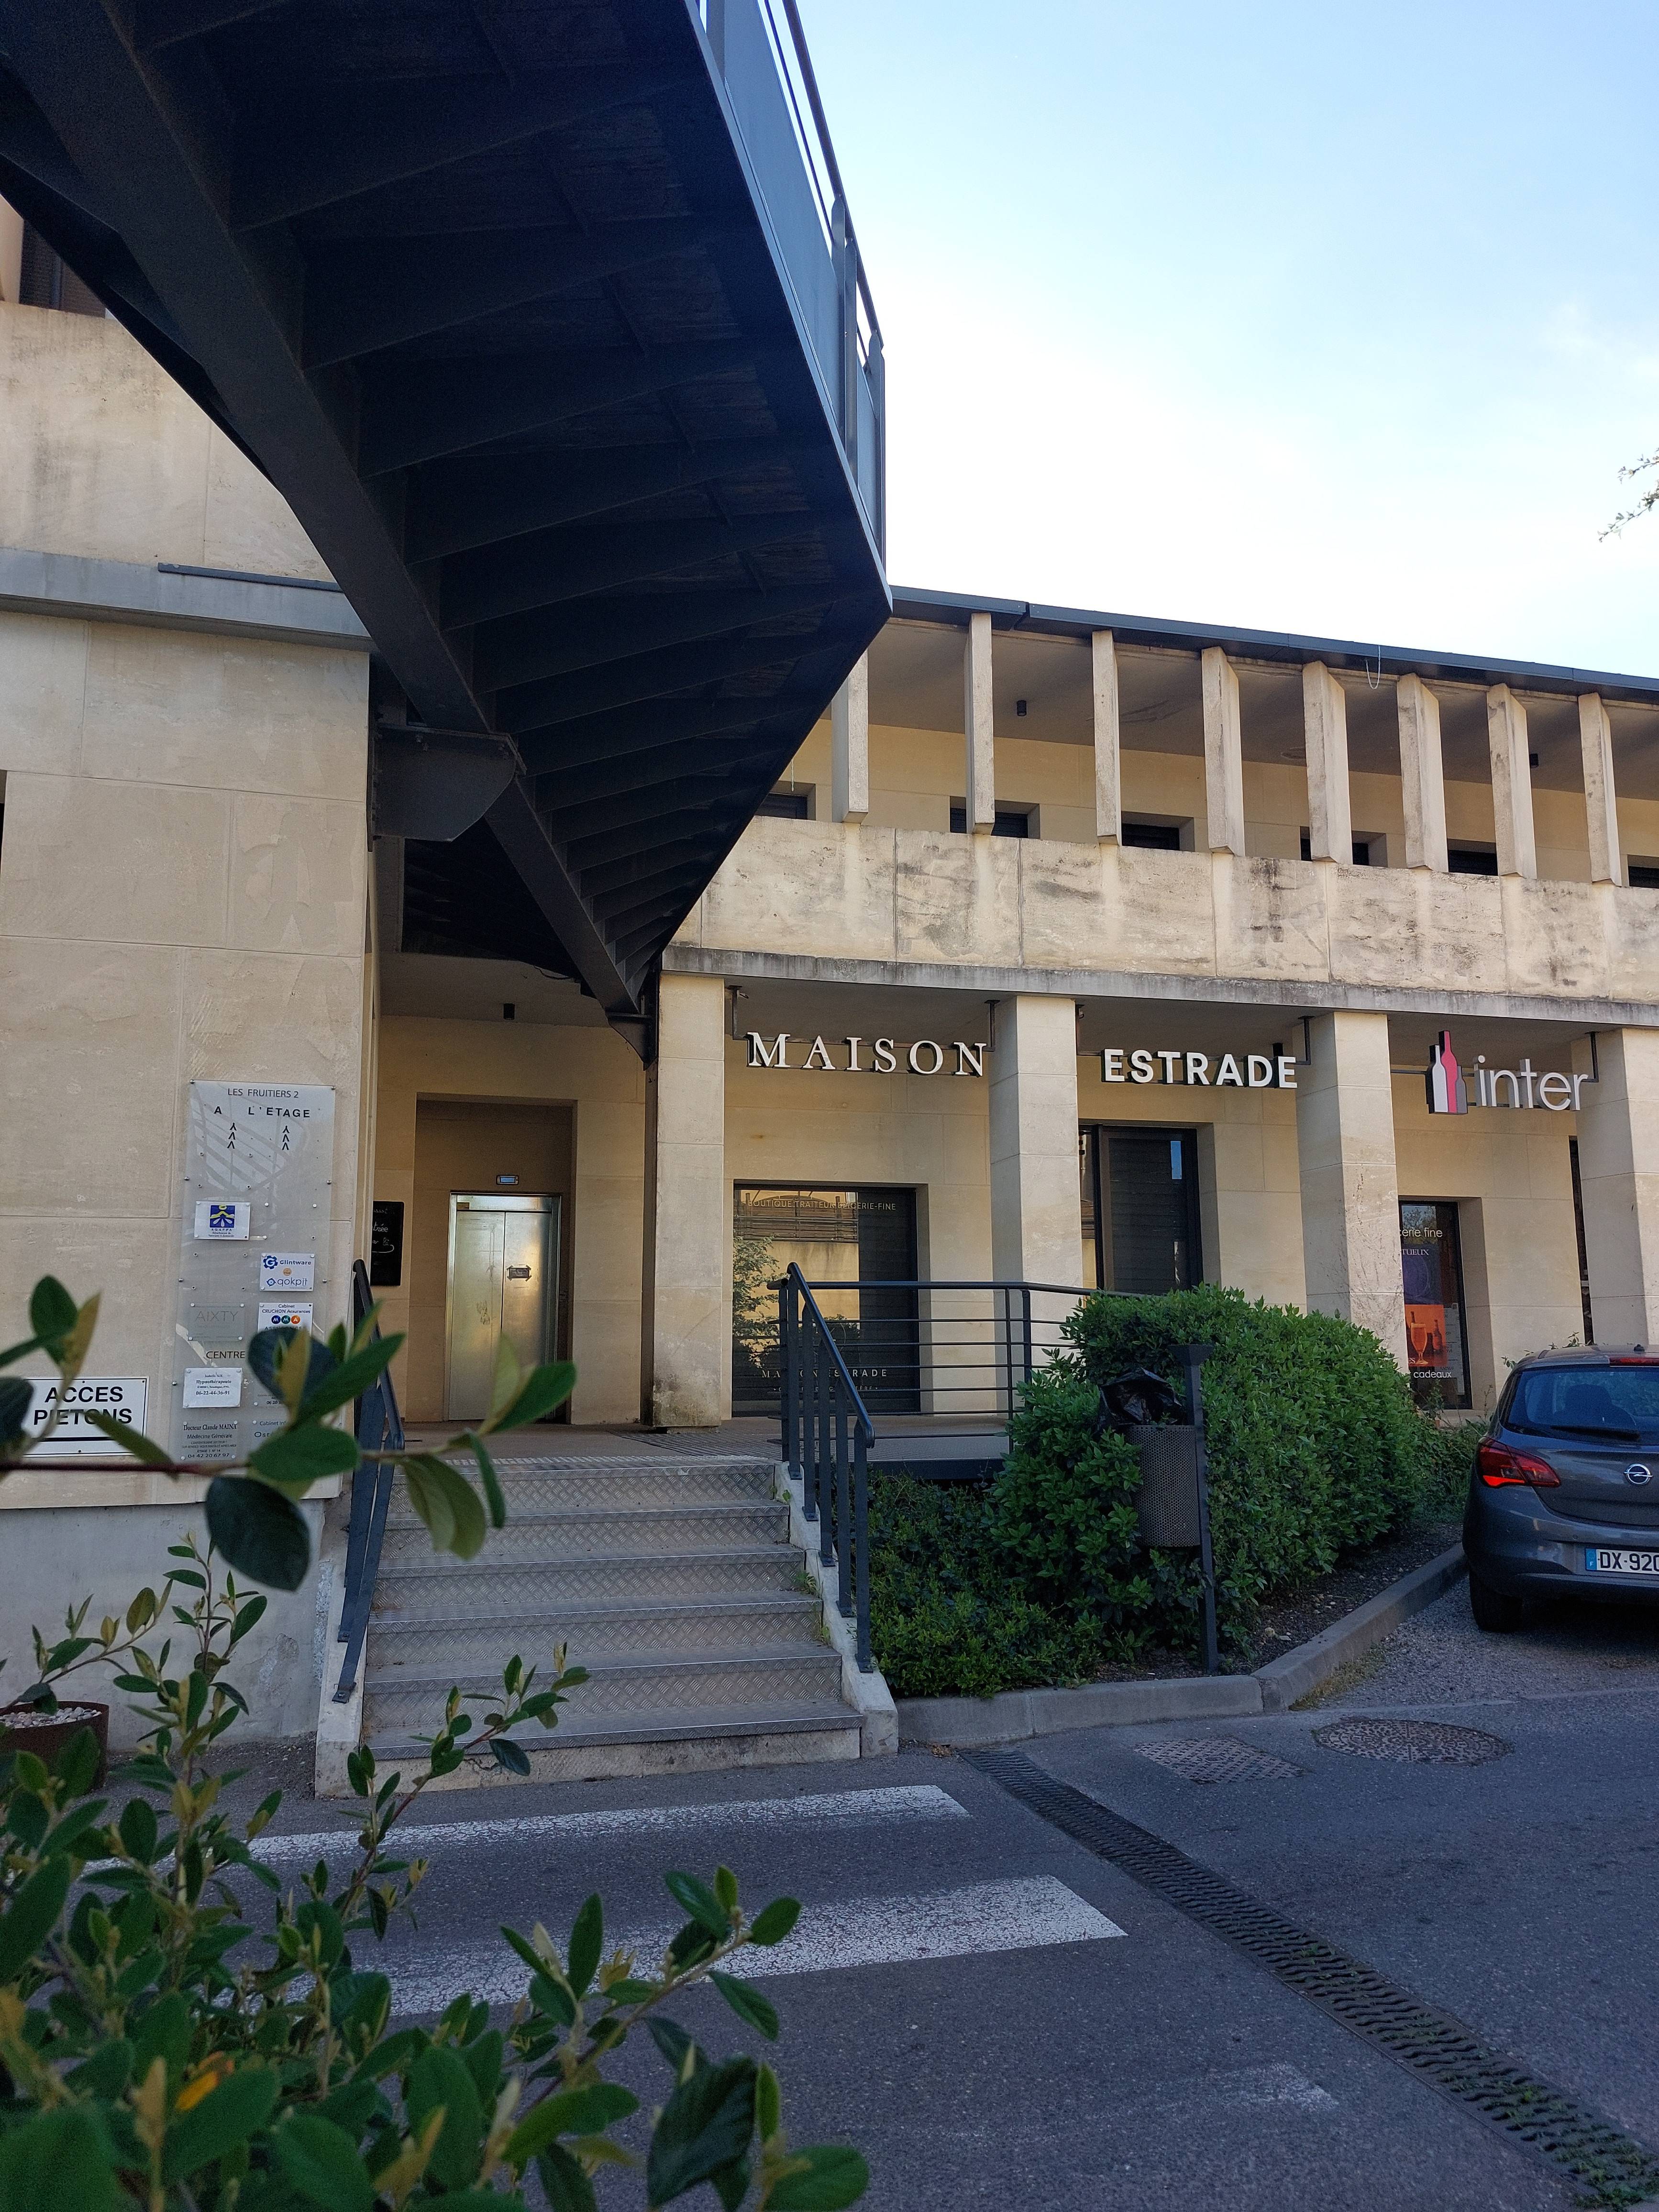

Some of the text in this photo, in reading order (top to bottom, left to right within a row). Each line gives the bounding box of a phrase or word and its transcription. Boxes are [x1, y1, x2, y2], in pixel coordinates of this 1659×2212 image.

[747, 1031, 987, 1076] MAISON
[1104, 1049, 1297, 1088] ESTRADE
[1477, 1055, 1588, 1110] inter
[248, 1089, 291, 1098] FRUITIERS
[214, 1106, 310, 1117] A L'ETAGE
[373, 1221, 388, 1232] trée
[1400, 1227, 1443, 1238] erie fine
[195, 1311, 238, 1321] AIXTY
[206, 1351, 245, 1359] CENTRE
[1413, 1370, 1452, 1378] cadeaux
[44, 1386, 123, 1403] ACCES
